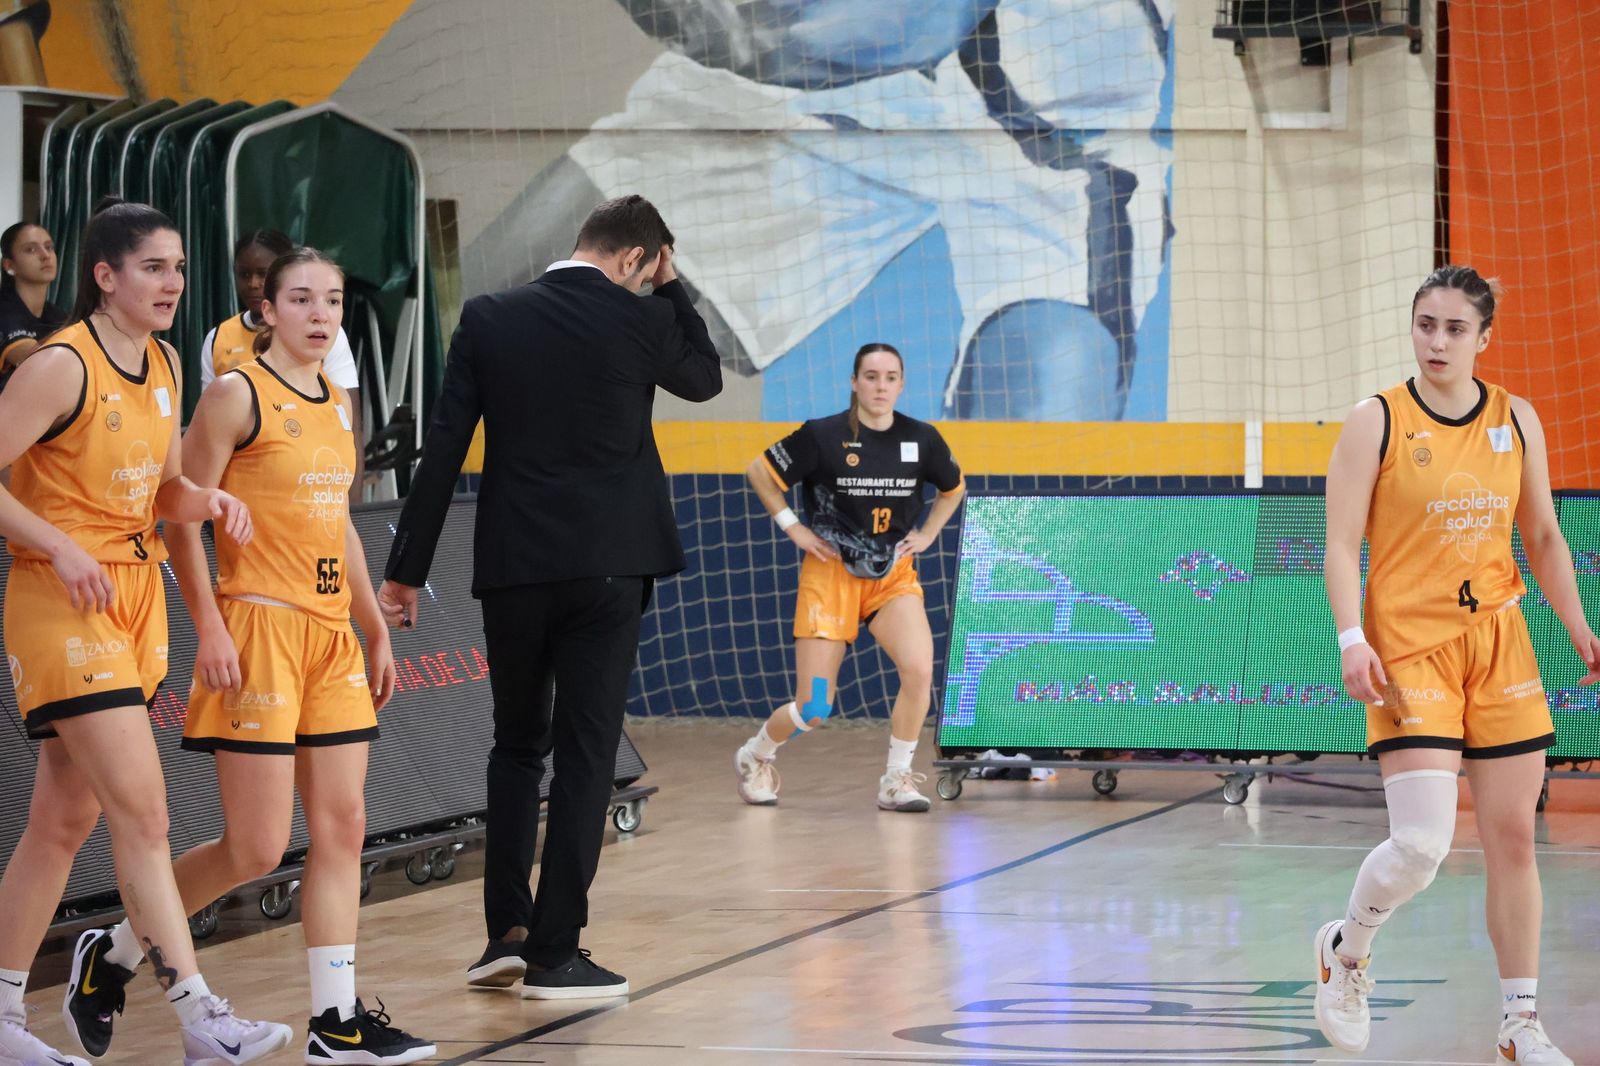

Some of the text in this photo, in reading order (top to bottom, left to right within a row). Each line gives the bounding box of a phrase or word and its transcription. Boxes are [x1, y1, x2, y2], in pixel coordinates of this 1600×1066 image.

[837, 477, 895, 487] RESTAURANTE
[848, 488, 874, 496] PUEBLA
[874, 488, 884, 497] DE
[1426, 490, 1511, 513] recoletas
[871, 506, 893, 535] 13
[1446, 511, 1493, 530] salud
[316, 557, 341, 595] 55
[1459, 579, 1479, 614] 4
[420, 652, 465, 687] DE
